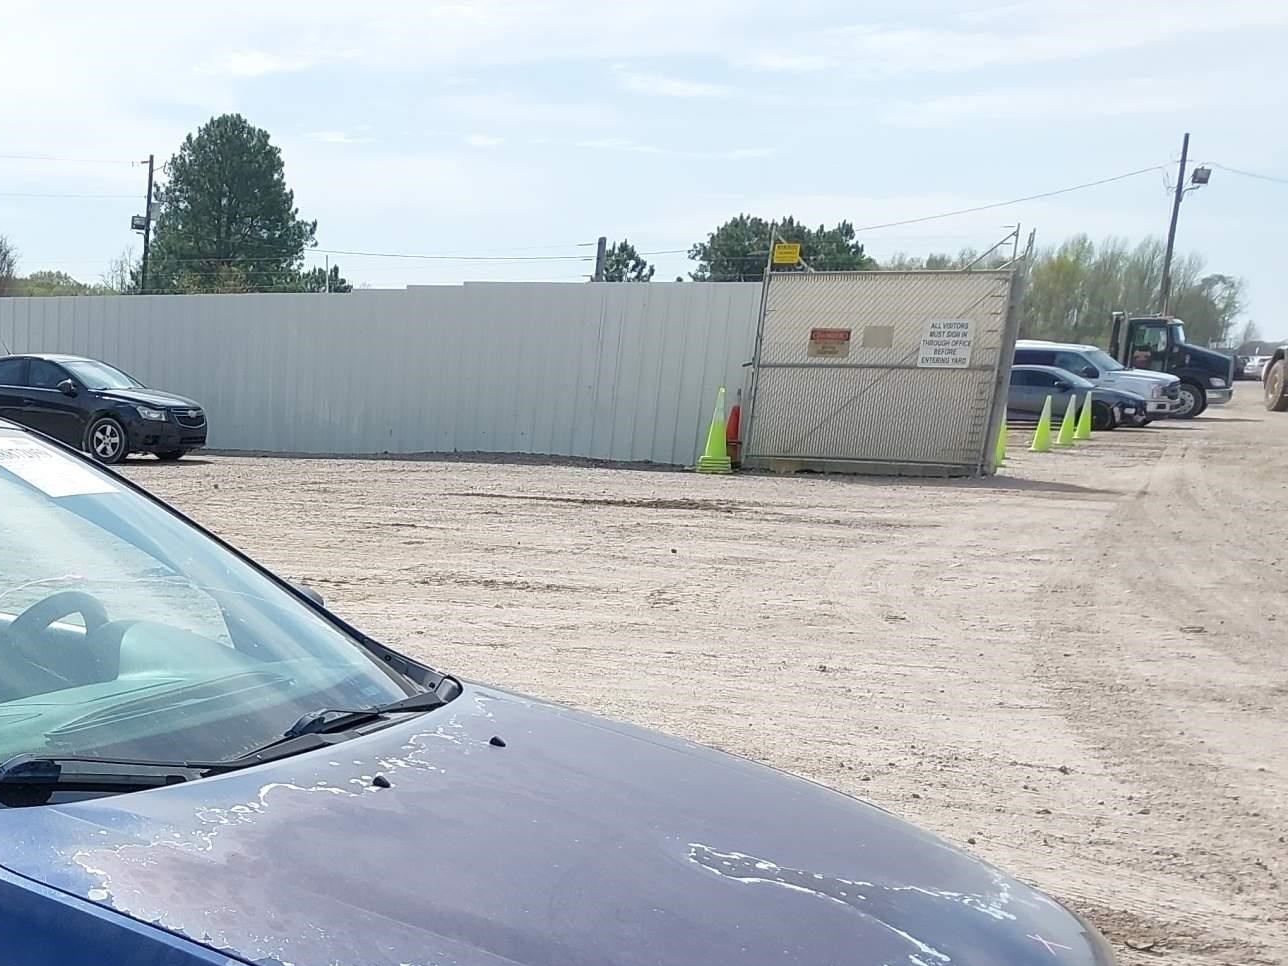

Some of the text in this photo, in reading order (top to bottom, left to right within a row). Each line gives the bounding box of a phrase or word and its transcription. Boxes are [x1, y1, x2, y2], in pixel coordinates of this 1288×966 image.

[922, 339, 972, 347] THROUGH OFFICE
[920, 356, 950, 364] ENTERING
